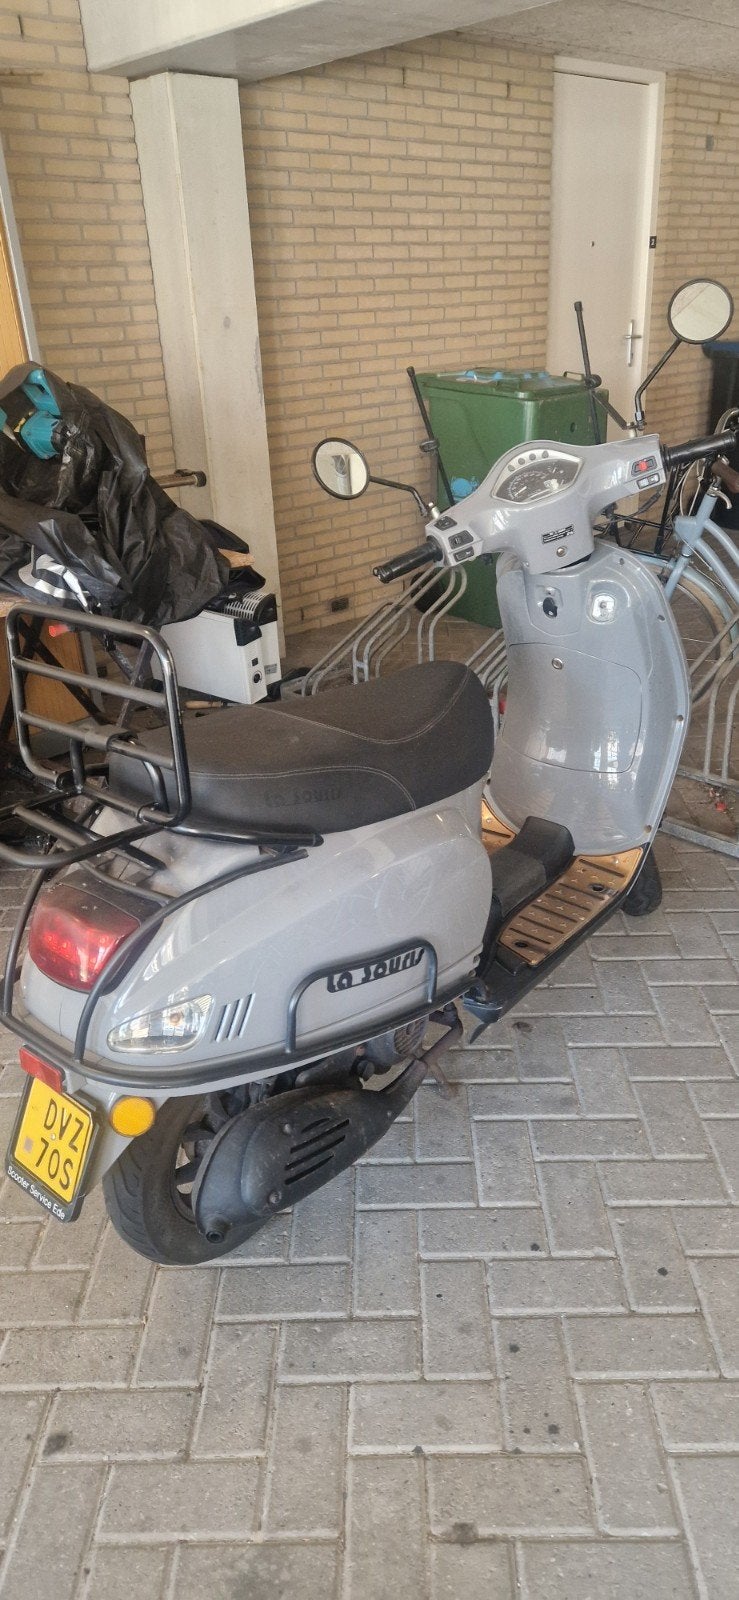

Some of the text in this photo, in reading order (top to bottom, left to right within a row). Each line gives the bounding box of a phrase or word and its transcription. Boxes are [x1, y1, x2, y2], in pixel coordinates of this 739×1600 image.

[44, 1098, 84, 1153] DVZ
[35, 1137, 74, 1191] 70S
[8, 1165, 66, 1220] Scooter Service Ede
